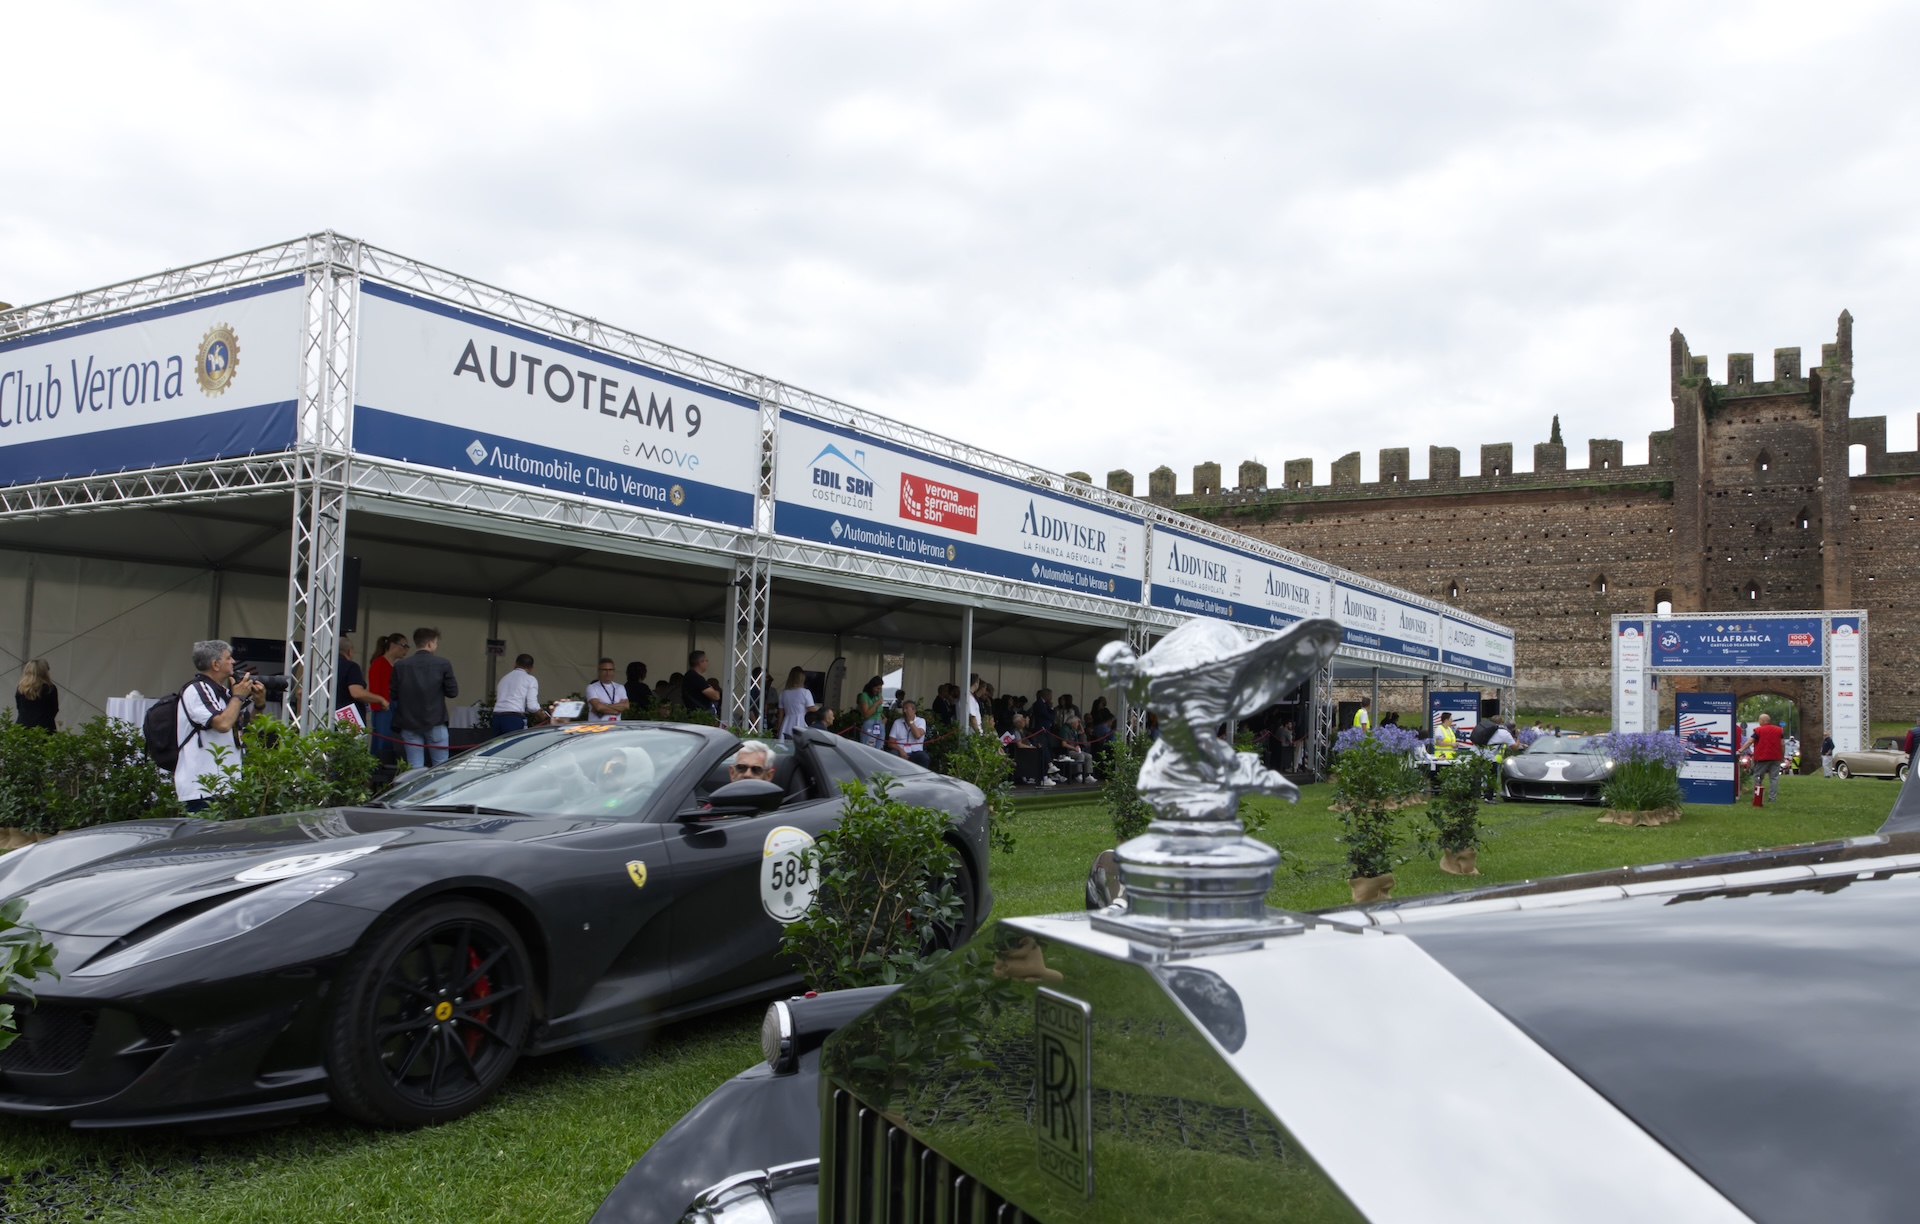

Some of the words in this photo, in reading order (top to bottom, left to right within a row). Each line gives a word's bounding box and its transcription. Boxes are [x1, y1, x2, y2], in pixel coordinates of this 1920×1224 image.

[0, 363, 61, 427] Club
[71, 355, 183, 414] Verona
[453, 339, 674, 432] AUTOTEAM
[686, 404, 701, 438] 9
[622, 440, 631, 455] è
[490, 446, 581, 484] Automobile
[586, 466, 617, 491] Club
[621, 474, 667, 502] Verona
[813, 468, 841, 490] EDIL
[846, 476, 873, 498] SBN
[812, 488, 873, 511] costruzioni
[925, 483, 959, 502] verona
[924, 495, 976, 519] serramenti
[924, 509, 943, 523] sbn
[1020, 498, 1106, 553] ADDVISER
[843, 523, 895, 549] Automobile
[897, 535, 916, 553] Club
[918, 539, 945, 559] Verona
[1023, 541, 1032, 550] LA
[1035, 543, 1063, 557] FINANZA
[1066, 553, 1103, 567] AGEVOLATA
[1167, 540, 1227, 584] ADDVISER
[1040, 565, 1074, 584] Automobile
[1075, 572, 1089, 587] Club
[1089, 575, 1108, 591] Verona
[1177, 577, 1197, 588] FINANZA
[1264, 568, 1310, 605] ADDVISER
[1180, 595, 1205, 610] Automobile
[1205, 600, 1214, 612] Club
[1214, 602, 1228, 616] Verona
[1343, 592, 1377, 621] ADDVISER
[1399, 608, 1427, 634] ADDVISER
[1700, 635, 1771, 643] VILLAFRANCA
[1039, 1001, 1079, 1035] ROLLS
[1040, 1144, 1081, 1185] ROYCE
